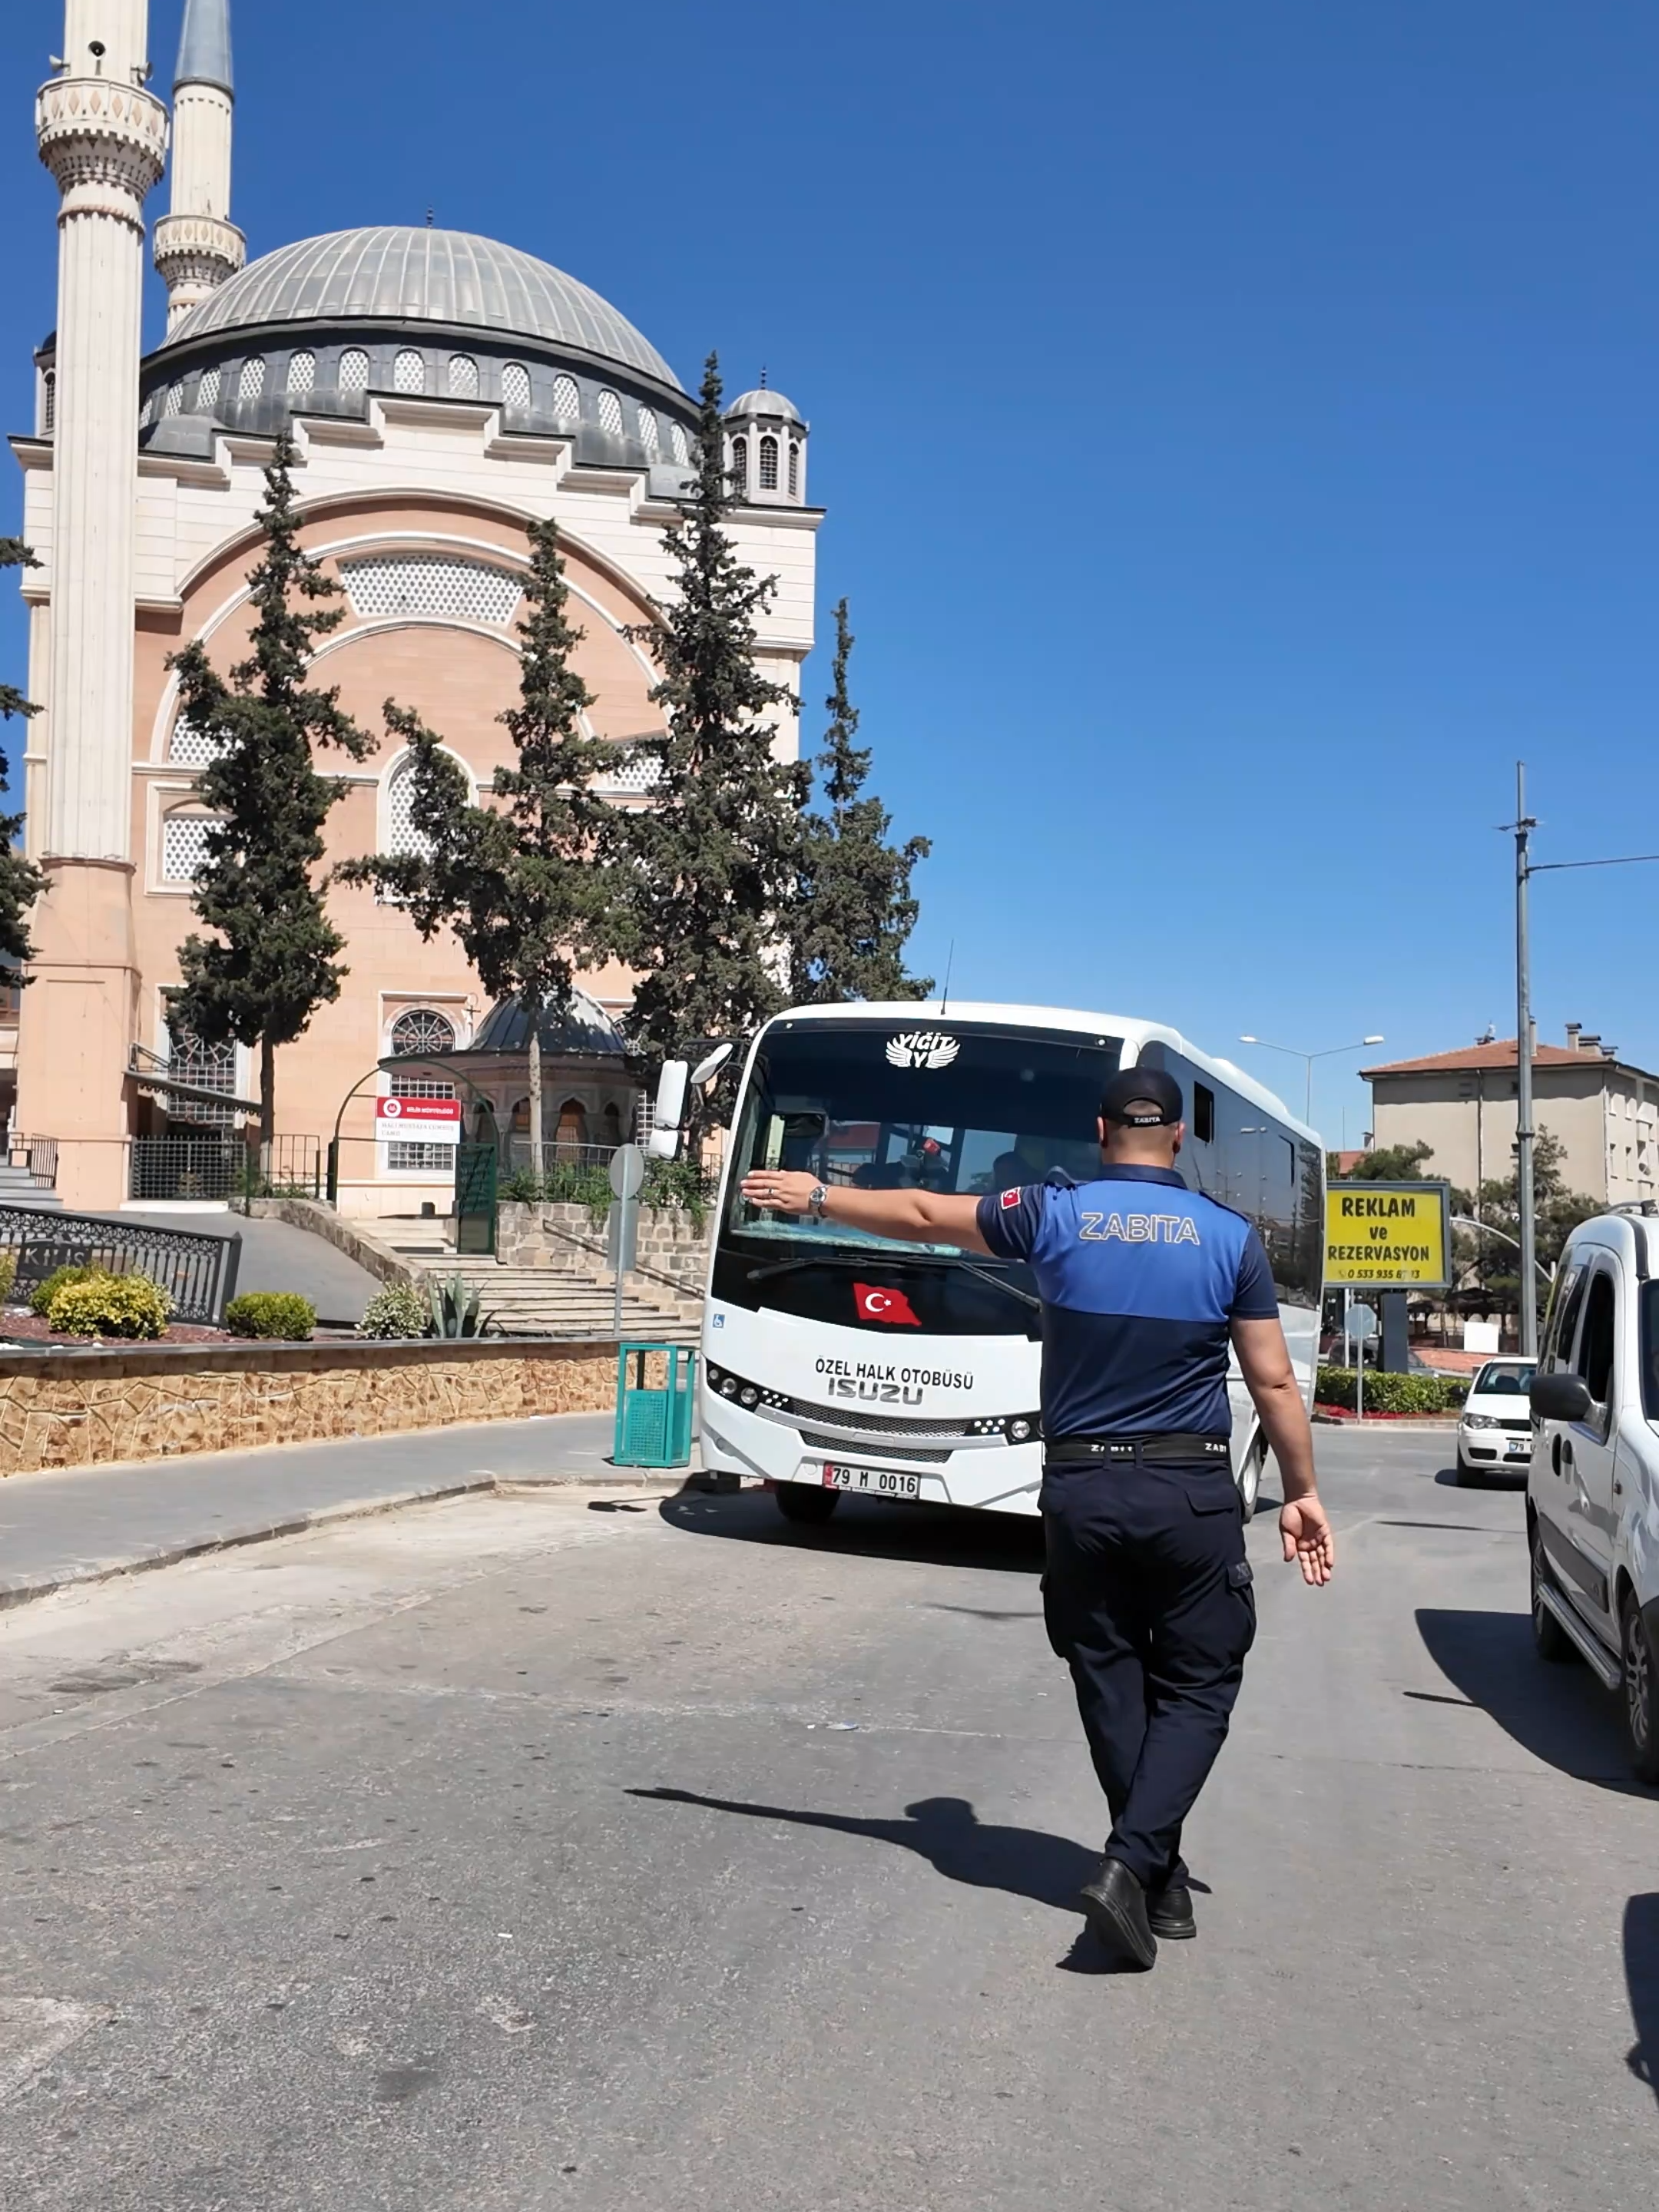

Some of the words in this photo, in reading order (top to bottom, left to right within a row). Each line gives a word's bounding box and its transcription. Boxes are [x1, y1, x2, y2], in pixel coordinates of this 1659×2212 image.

[1341, 1197, 1416, 1218] REKLAM
[1079, 1212, 1200, 1246] ZABITA
[1369, 1226, 1388, 1240] ve
[1328, 1245, 1429, 1262] REZERVASYON
[1348, 1269, 1355, 1279] 0
[1356, 1269, 1374, 1279] 533
[1376, 1270, 1394, 1279] 935
[815, 1354, 851, 1376] ÖZEL
[856, 1363, 896, 1382] HALK
[901, 1368, 974, 1390] OTOBÜSÜ
[828, 1377, 923, 1406] ISUZU
[833, 1467, 850, 1485] 79
[879, 1474, 916, 1494] 0016
